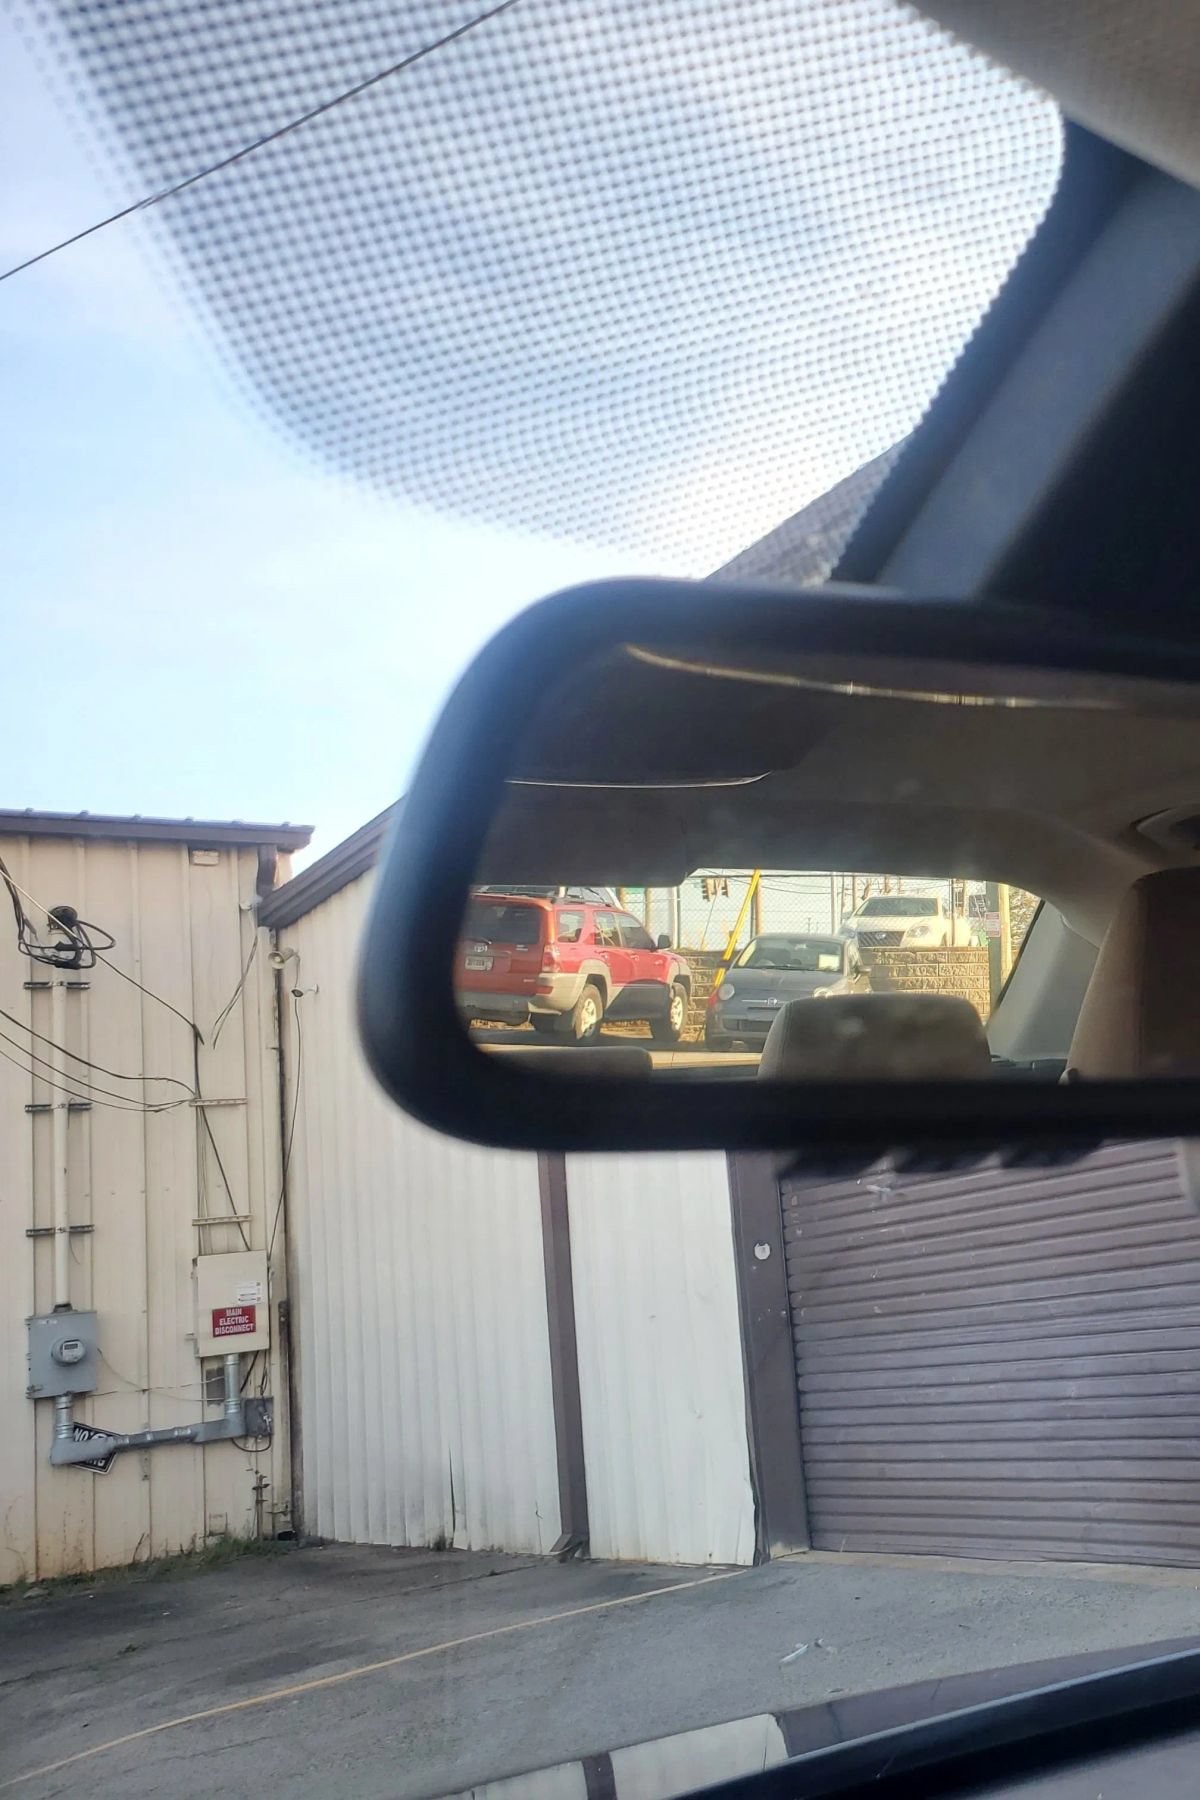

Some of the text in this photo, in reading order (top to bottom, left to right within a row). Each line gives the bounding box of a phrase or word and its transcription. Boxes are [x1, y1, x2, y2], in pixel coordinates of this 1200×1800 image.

[225, 1308, 243, 1316] MAIN
[219, 1315, 249, 1326] ELECTRIC
[215, 1323, 254, 1335] DISCONNECT
